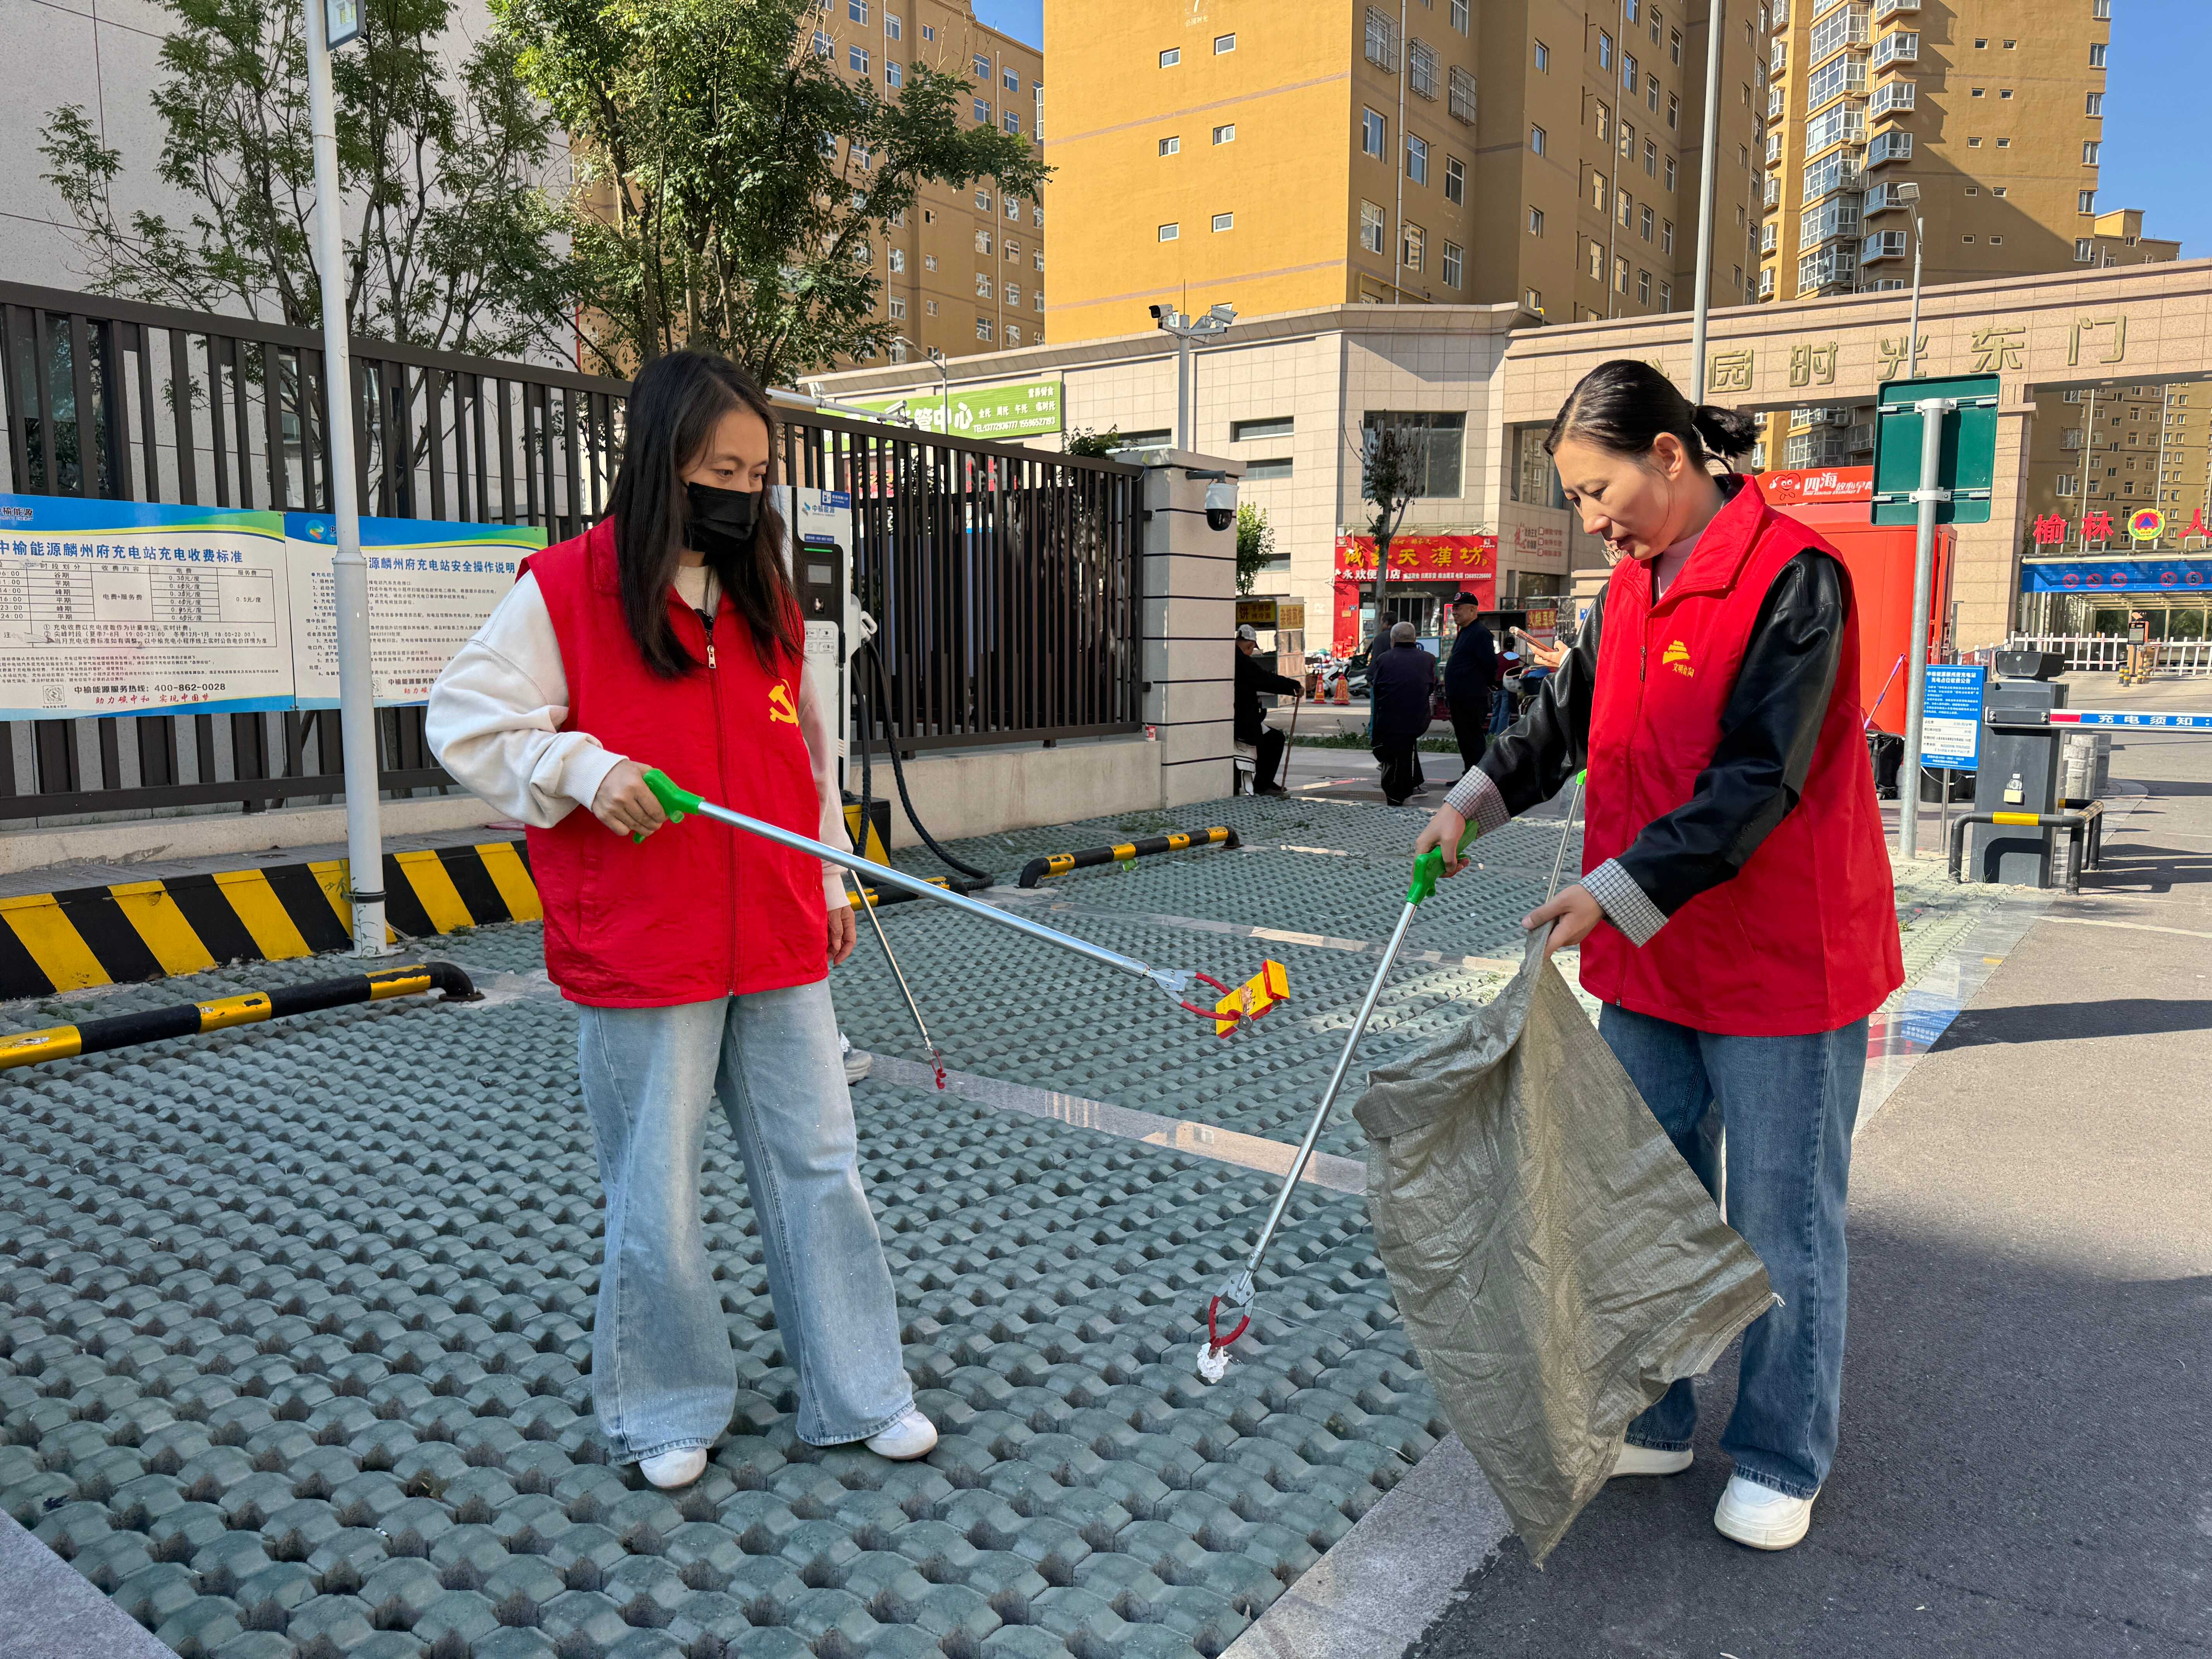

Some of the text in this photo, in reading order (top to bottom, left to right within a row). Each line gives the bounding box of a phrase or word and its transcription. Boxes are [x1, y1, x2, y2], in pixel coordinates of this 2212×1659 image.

[1643, 314, 2127, 393] 园时光东门
[1015, 404, 1028, 414] 午托
[0, 507, 33, 517] 榆能源
[2033, 508, 2212, 544] 榆林 人
[0, 539, 243, 563] 中榆能源麟州府充电站充电收费标准
[364, 557, 515, 574] 源麟州府充电站安全操作说明
[1343, 568, 1401, 580] 永欢便店
[154, 683, 226, 692] 400-862-0028
[96, 693, 209, 704] 助力碳中和 实现中国梦
